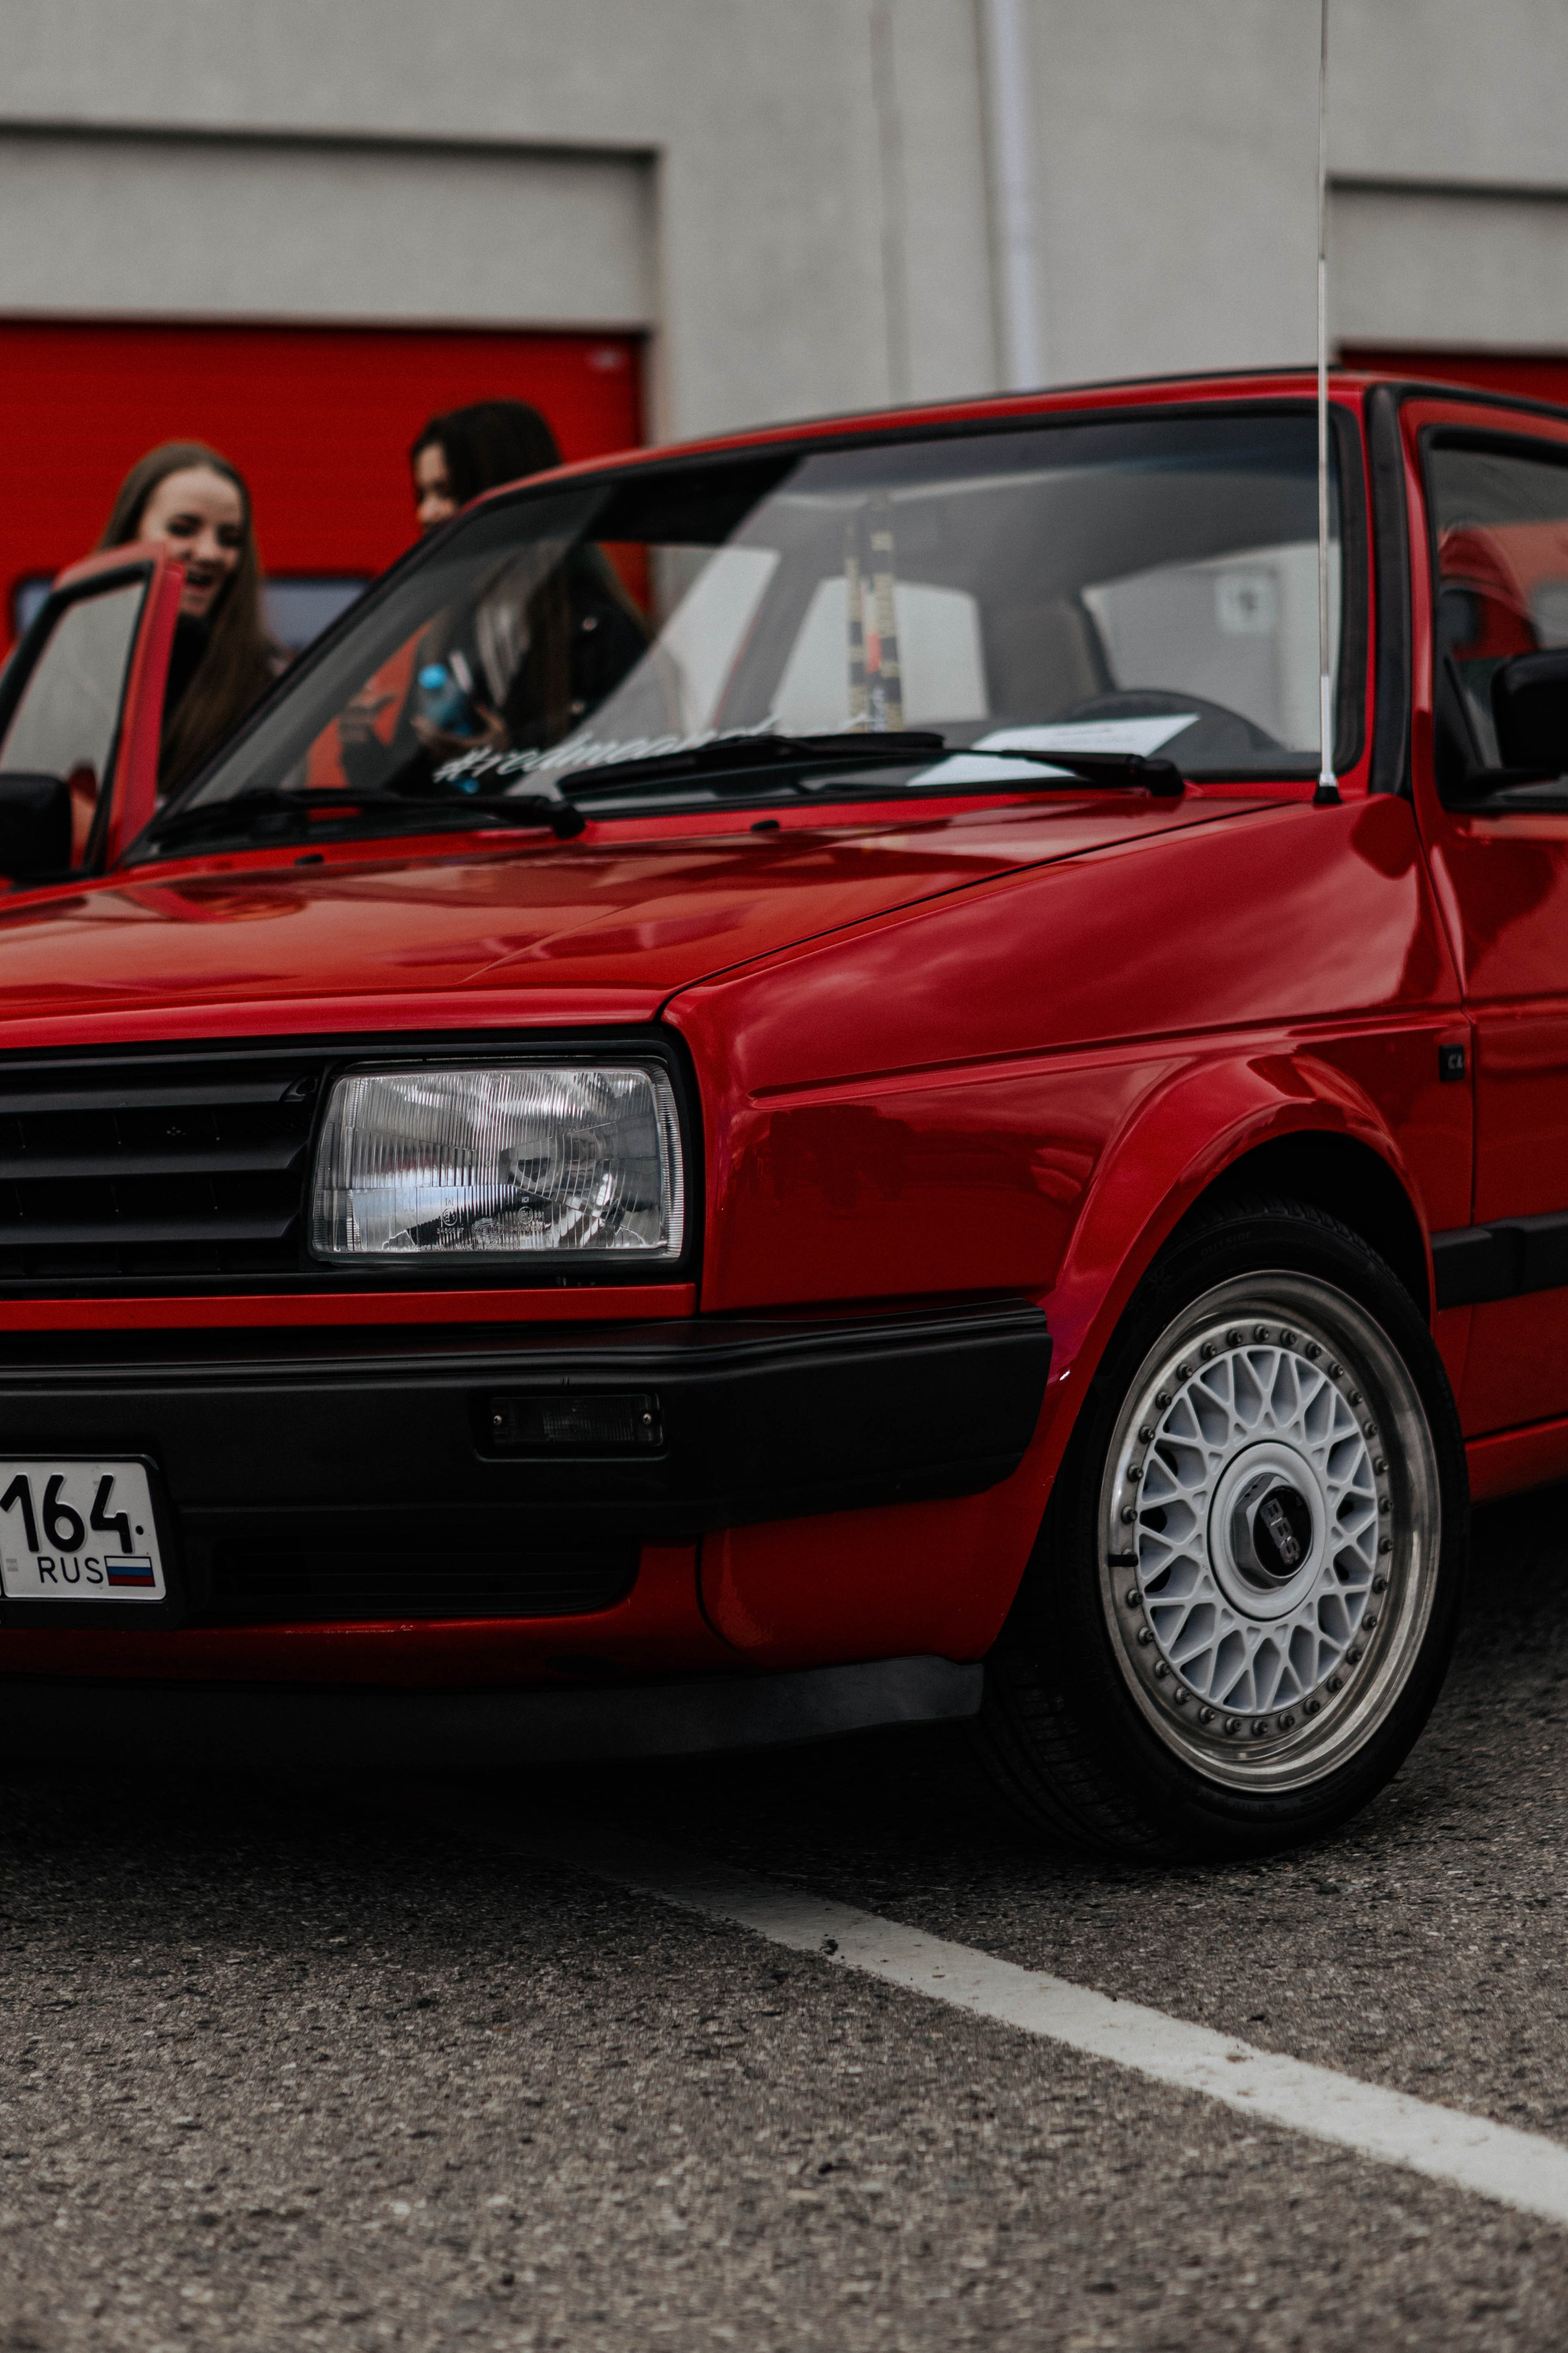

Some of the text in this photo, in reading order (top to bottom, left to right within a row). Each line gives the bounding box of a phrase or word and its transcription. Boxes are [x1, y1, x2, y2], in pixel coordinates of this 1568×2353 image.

[0, 1474, 133, 1554] 164
[1259, 1498, 1300, 1565] BBS
[37, 1556, 104, 1584] RUS
